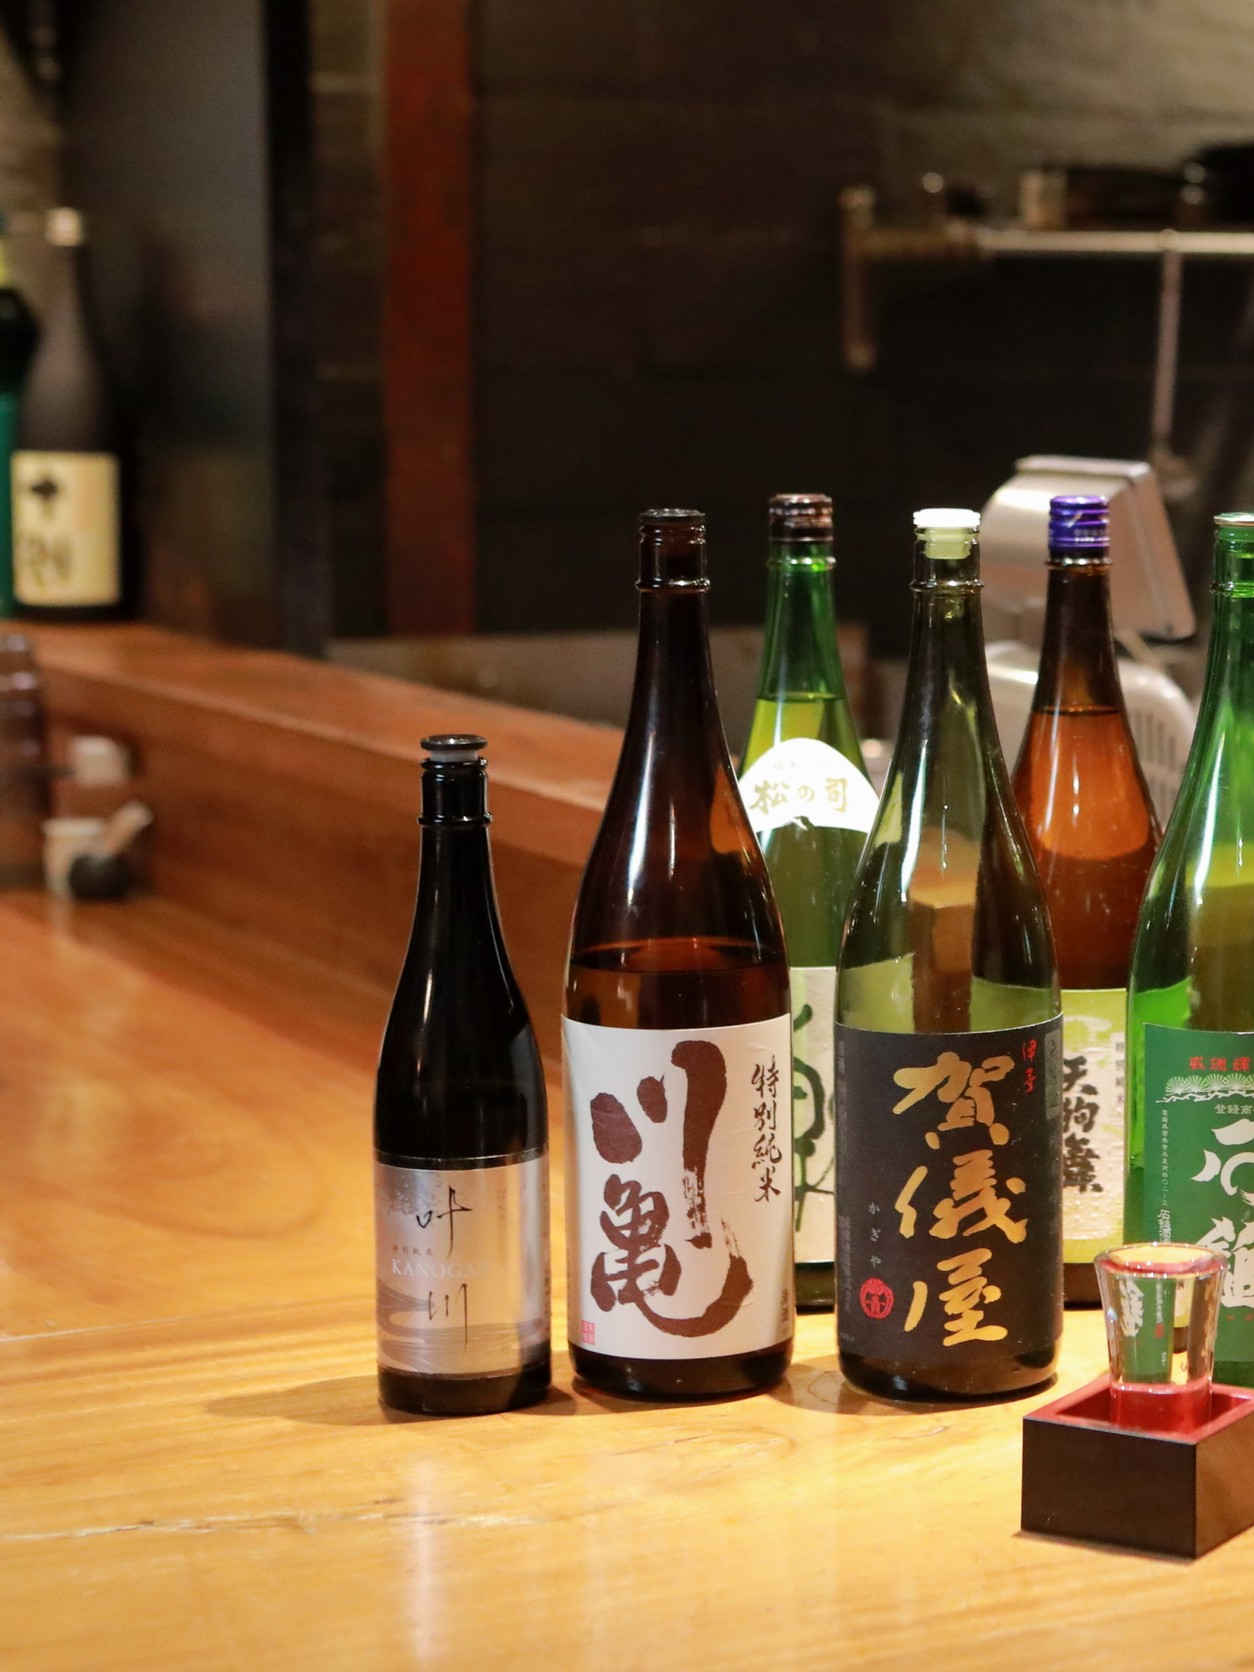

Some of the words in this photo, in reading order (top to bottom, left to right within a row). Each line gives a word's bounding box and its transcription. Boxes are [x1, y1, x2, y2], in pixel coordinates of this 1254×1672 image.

[750, 777, 848, 815] 松の司
[750, 1054, 782, 1203] 特別純米
[868, 1202, 882, 1267] かぎや
[892, 1051, 1029, 1347] 賀儀屋
